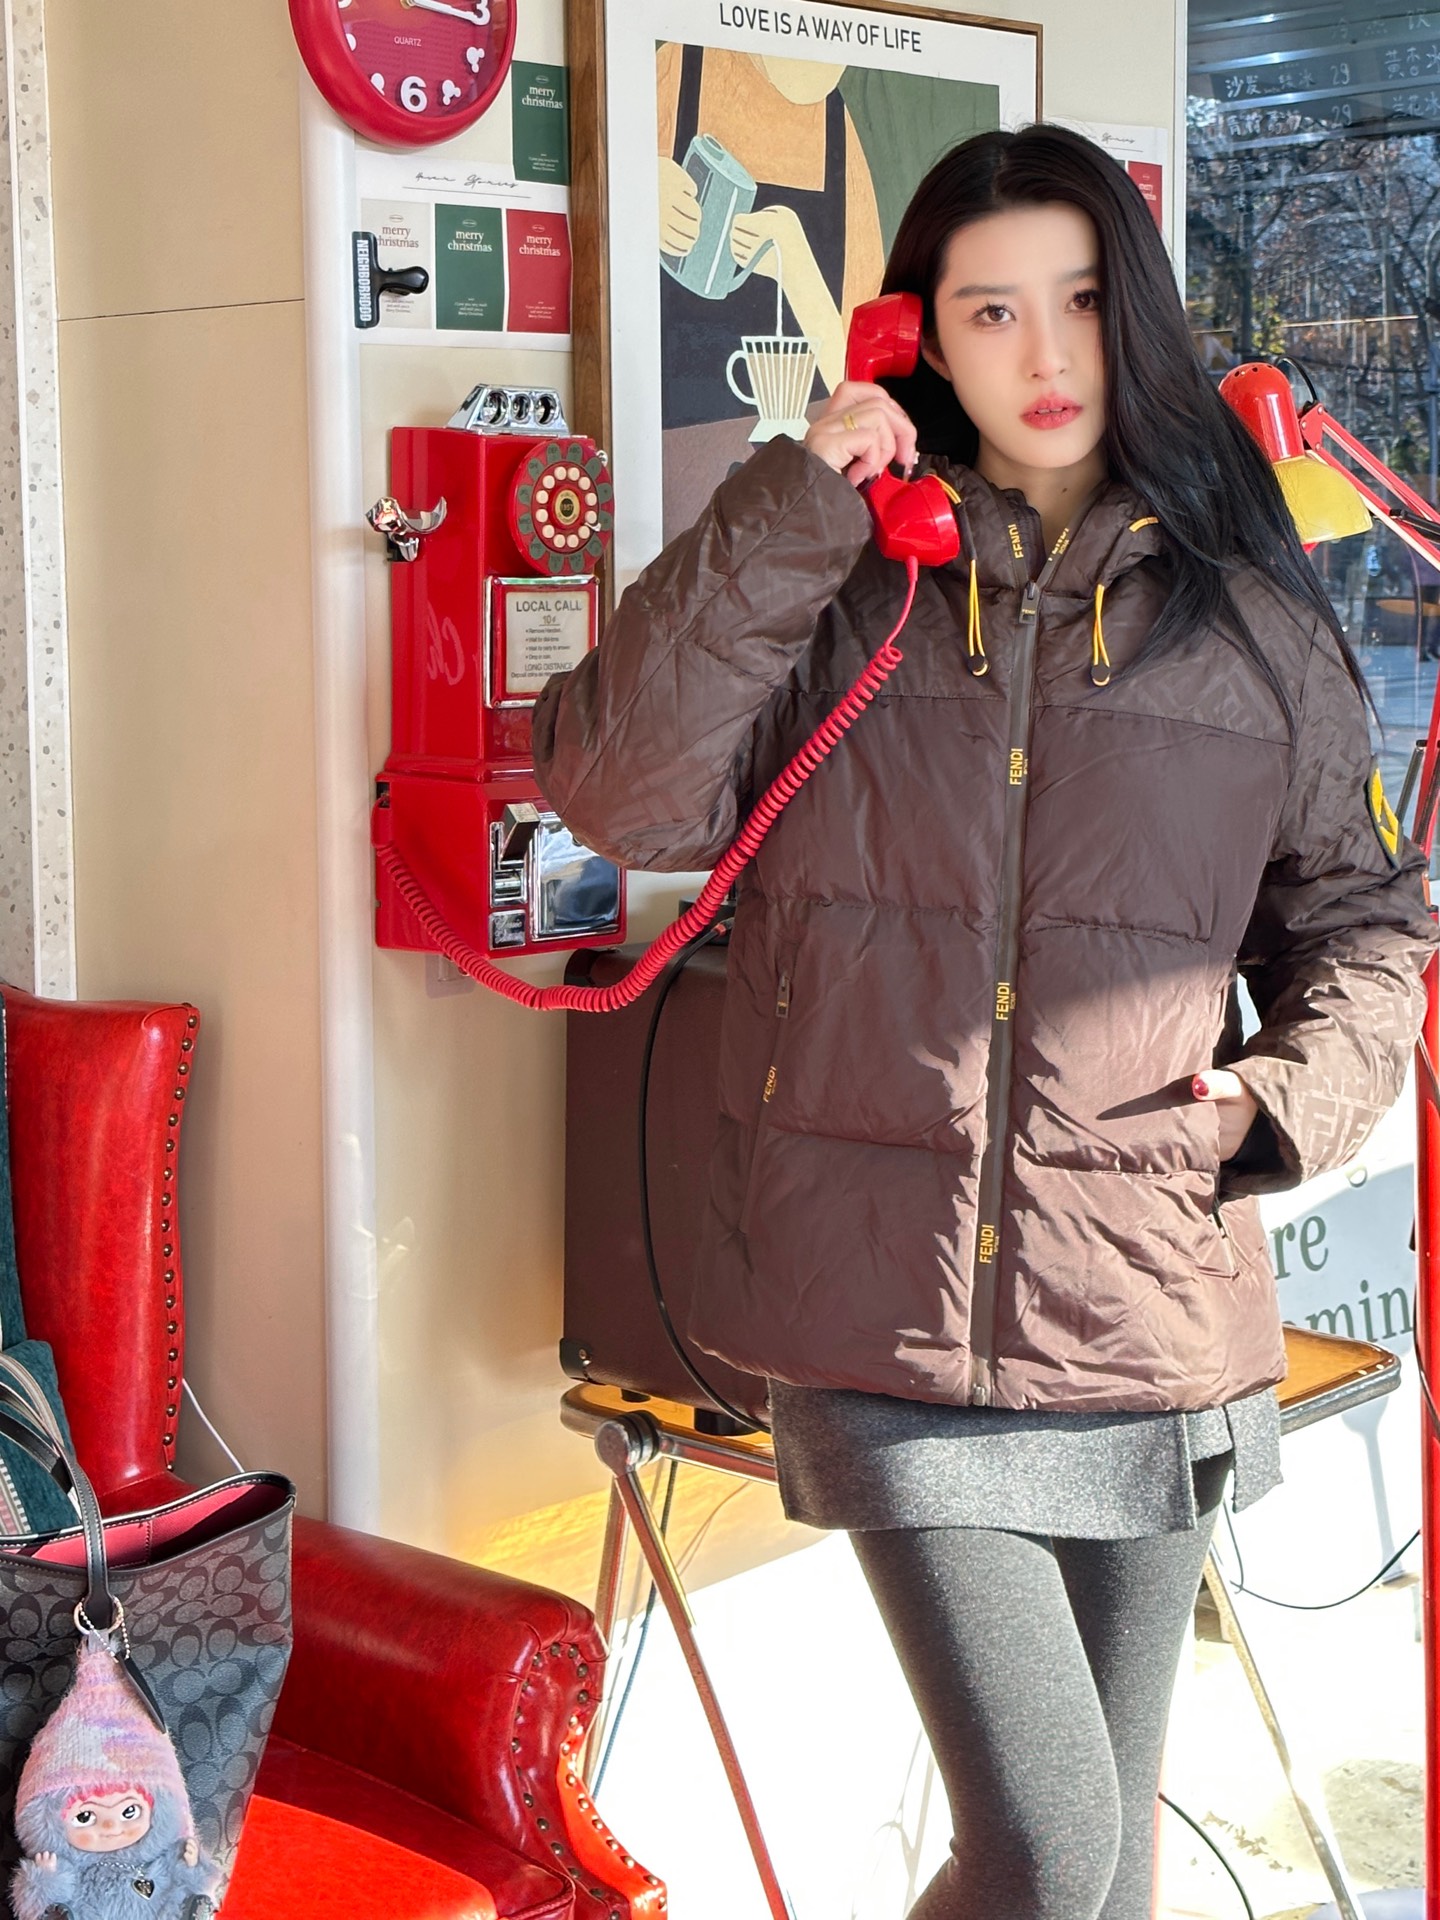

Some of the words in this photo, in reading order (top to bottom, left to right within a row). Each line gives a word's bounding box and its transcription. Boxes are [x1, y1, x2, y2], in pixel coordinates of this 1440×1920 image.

[719, 2, 771, 32] LOVE
[774, 11, 792, 35] IS
[796, 15, 810, 37] A
[811, 16, 853, 42] WAY
[856, 23, 880, 46] OF
[883, 26, 923, 53] LIFE
[393, 35, 422, 47] QUARTZ
[400, 75, 428, 113] 6
[529, 86, 556, 100] merry
[521, 94, 564, 109] christmas
[382, 226, 412, 239] merry
[455, 230, 485, 244] merry
[447, 240, 493, 253] christmas
[526, 235, 553, 249] merry
[518, 244, 561, 257] christmas
[356, 239, 372, 322] NEIGHBORHOOD
[515, 600, 552, 612] LOCAL
[554, 599, 582, 612] CALL
[524, 663, 543, 672] LONG
[543, 661, 574, 671] DISTANCE
[1009, 747, 1024, 786] FENDI
[995, 981, 1011, 1021] FENDI
[762, 1065, 777, 1103] FENDI
[978, 1223, 996, 1264] FENDI
